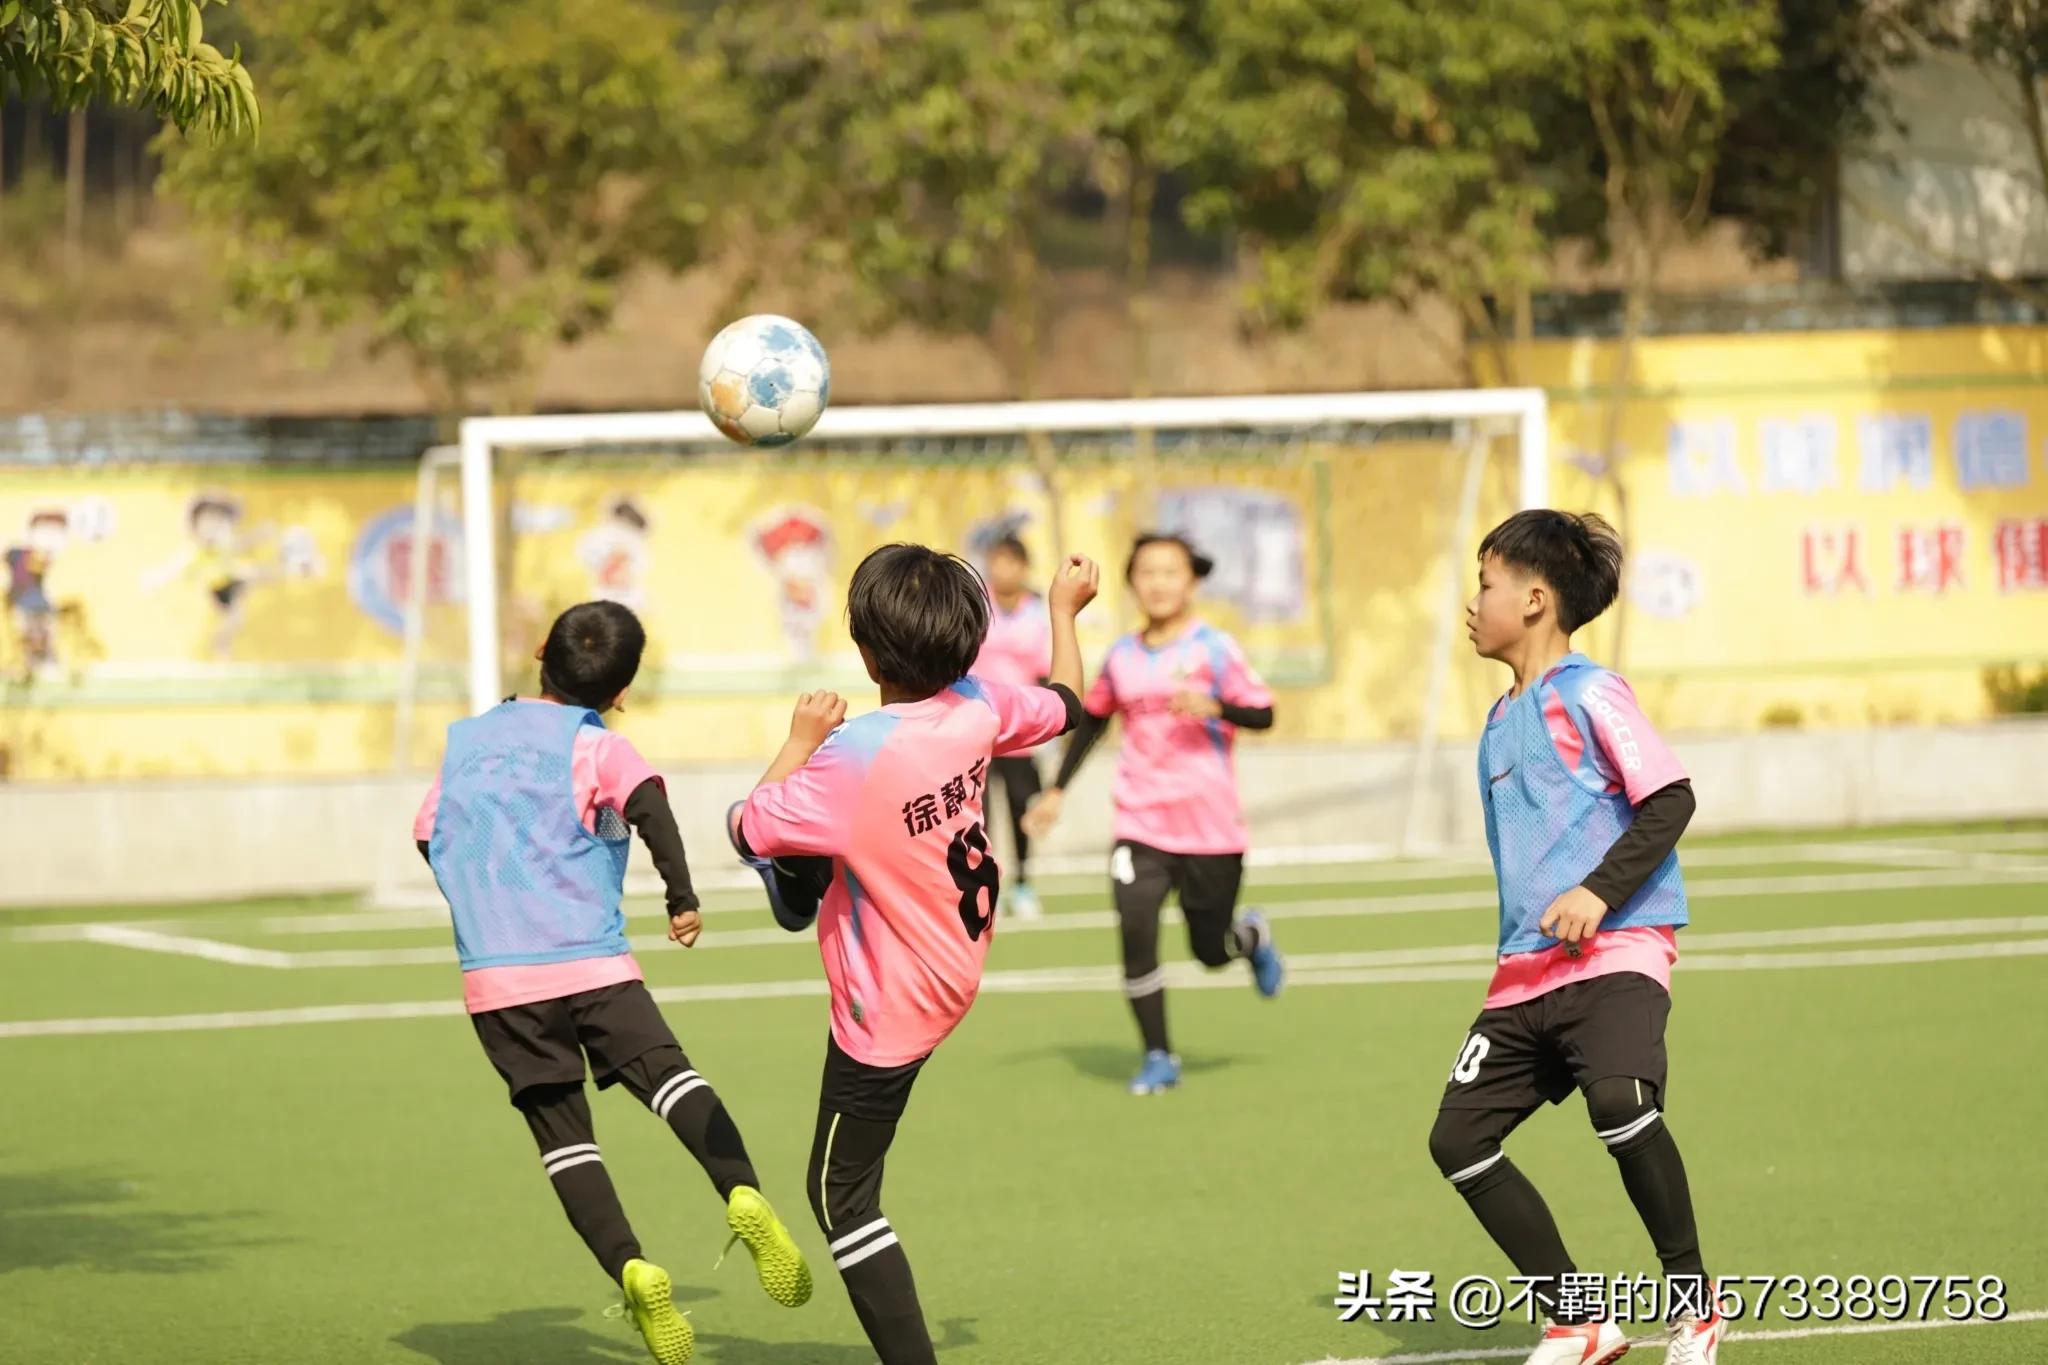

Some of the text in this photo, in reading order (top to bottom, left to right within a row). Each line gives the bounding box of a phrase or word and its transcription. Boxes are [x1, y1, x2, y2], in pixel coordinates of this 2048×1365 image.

[1582, 685, 1641, 771] SOCCER
[946, 820, 1000, 943] 8
[1448, 1031, 1491, 1084] 0
